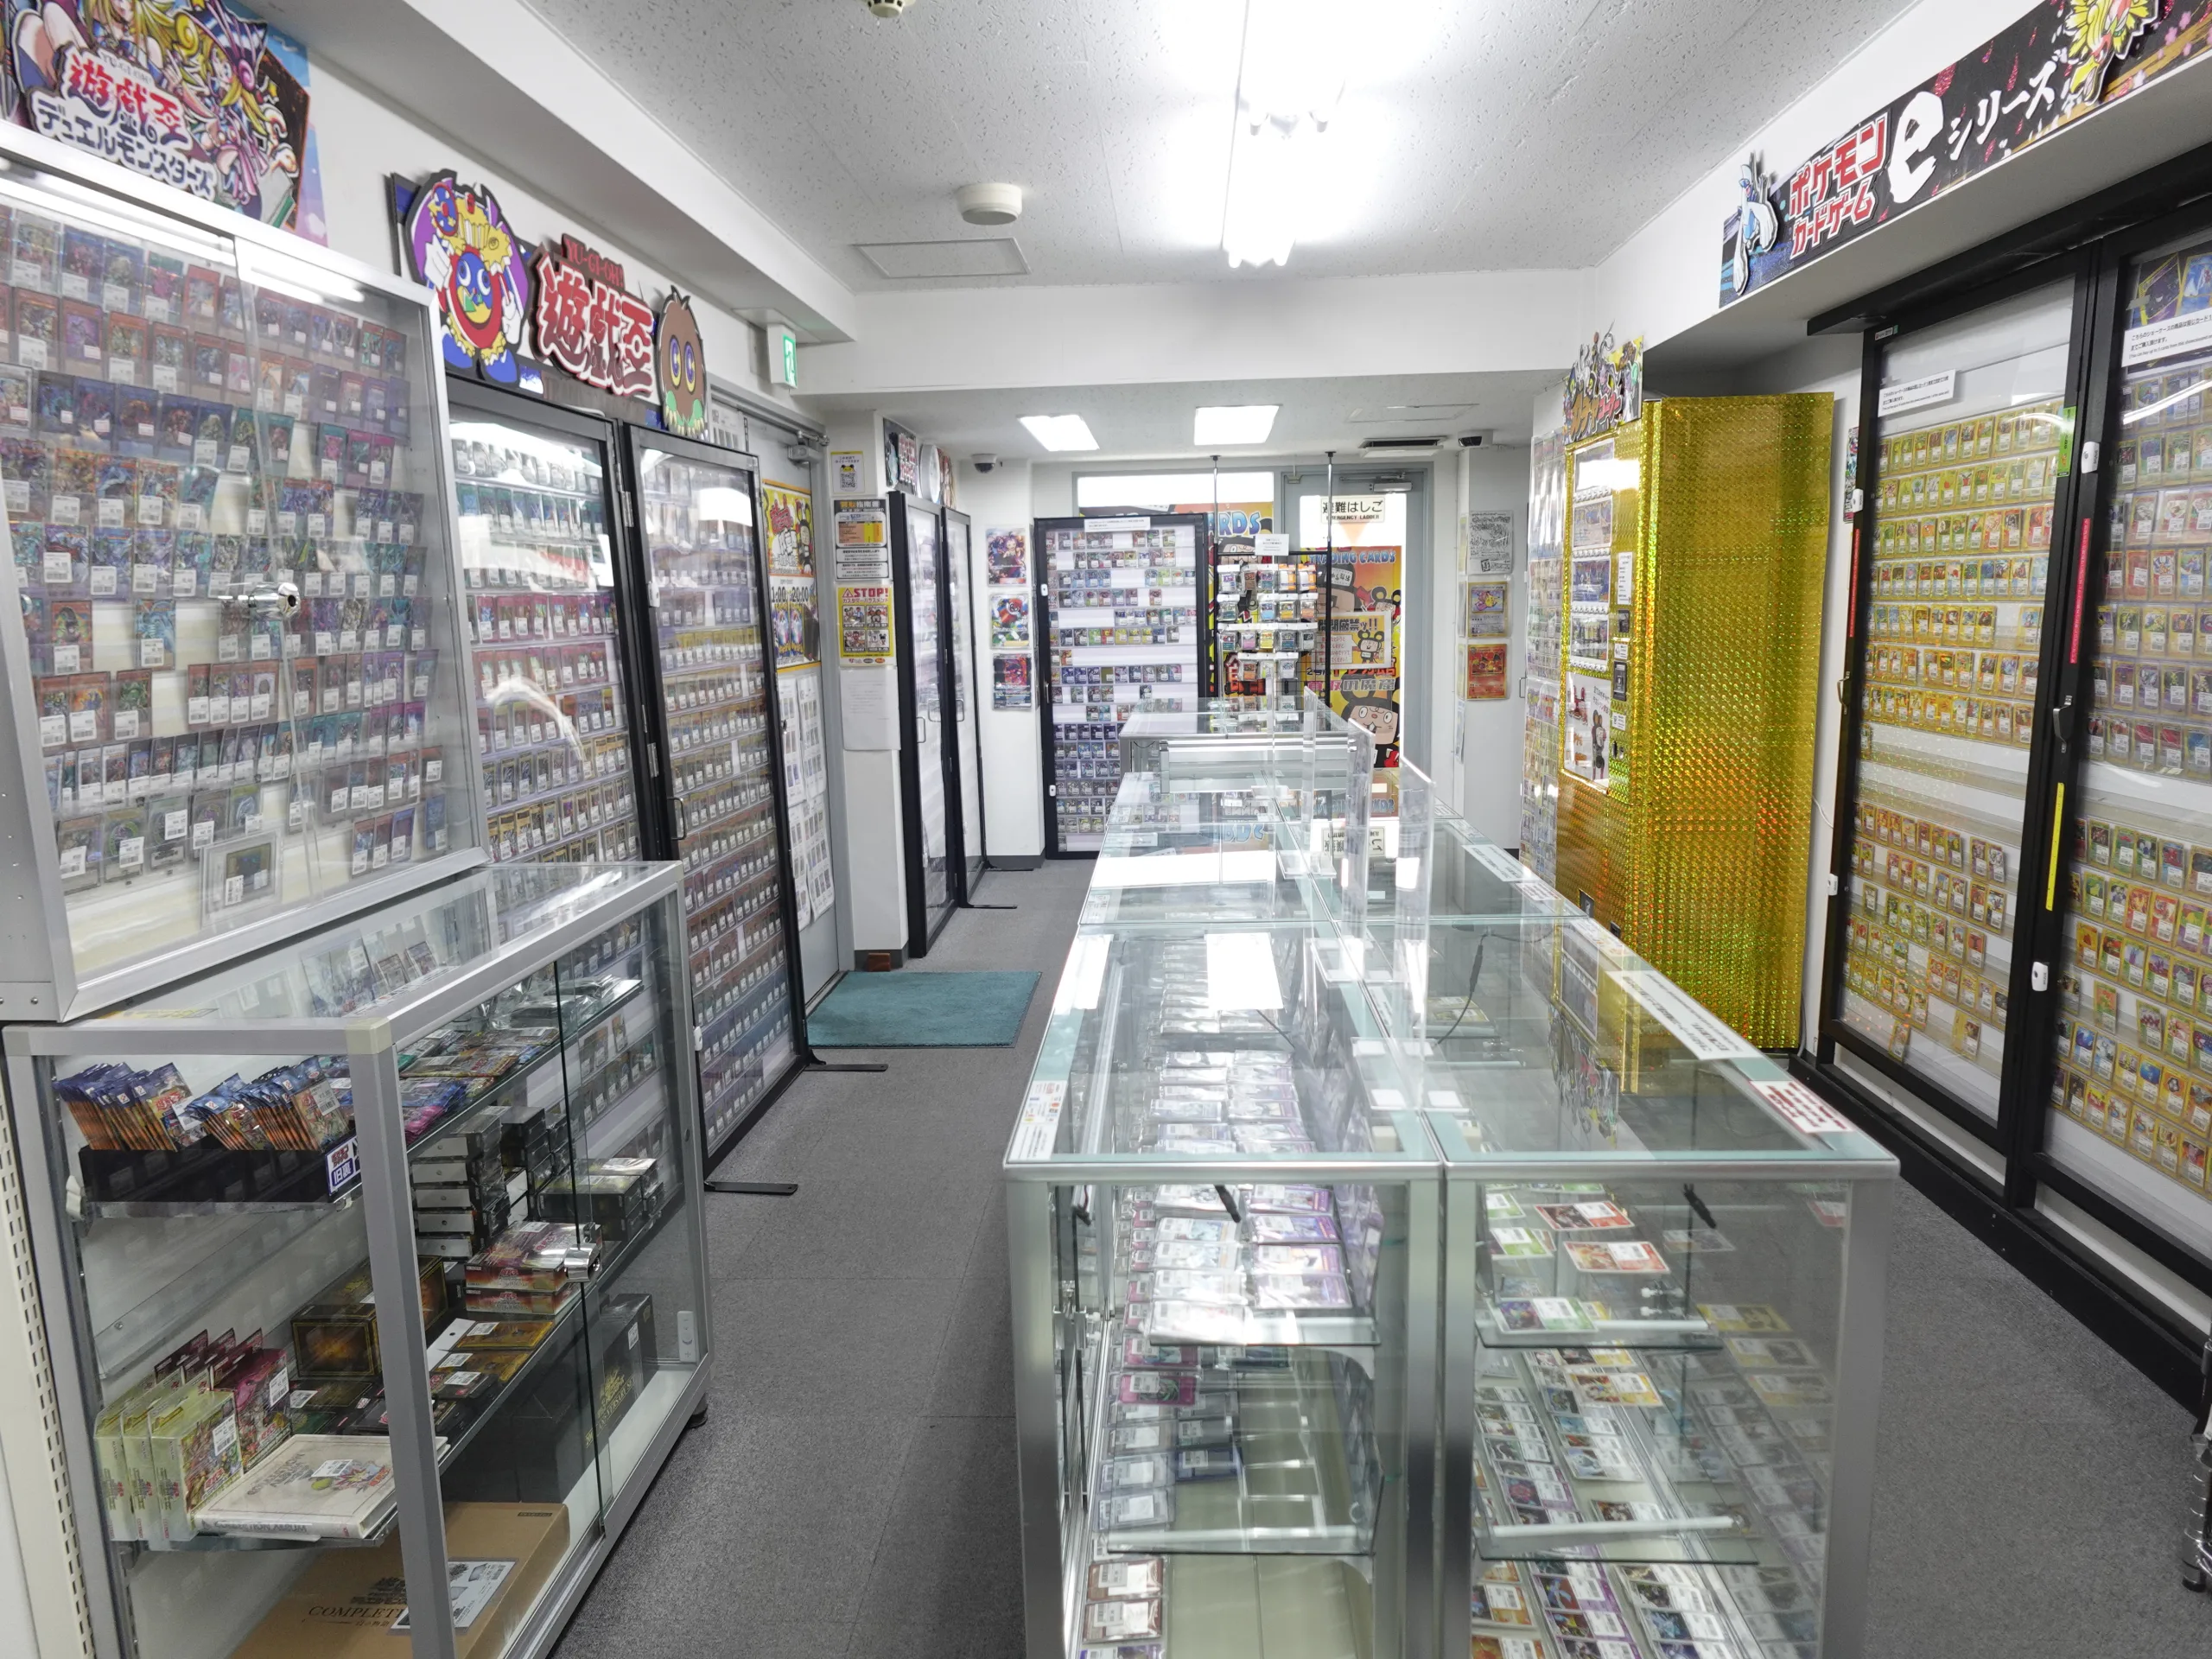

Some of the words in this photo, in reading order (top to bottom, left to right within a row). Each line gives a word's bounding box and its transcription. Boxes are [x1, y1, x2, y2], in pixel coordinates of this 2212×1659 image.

[1948, 49, 2067, 161] シリーズ
[38, 98, 213, 197] デュエルモンスターズ
[1789, 113, 1888, 219] ポケモン
[1790, 178, 1876, 258] カードゲーム
[566, 239, 624, 288] YU-GI-OH!
[537, 255, 654, 394] 遊戯王
[1323, 500, 1383, 513] 避難はしご
[854, 588, 889, 598] STOP!
[1359, 550, 1396, 564] CARDS
